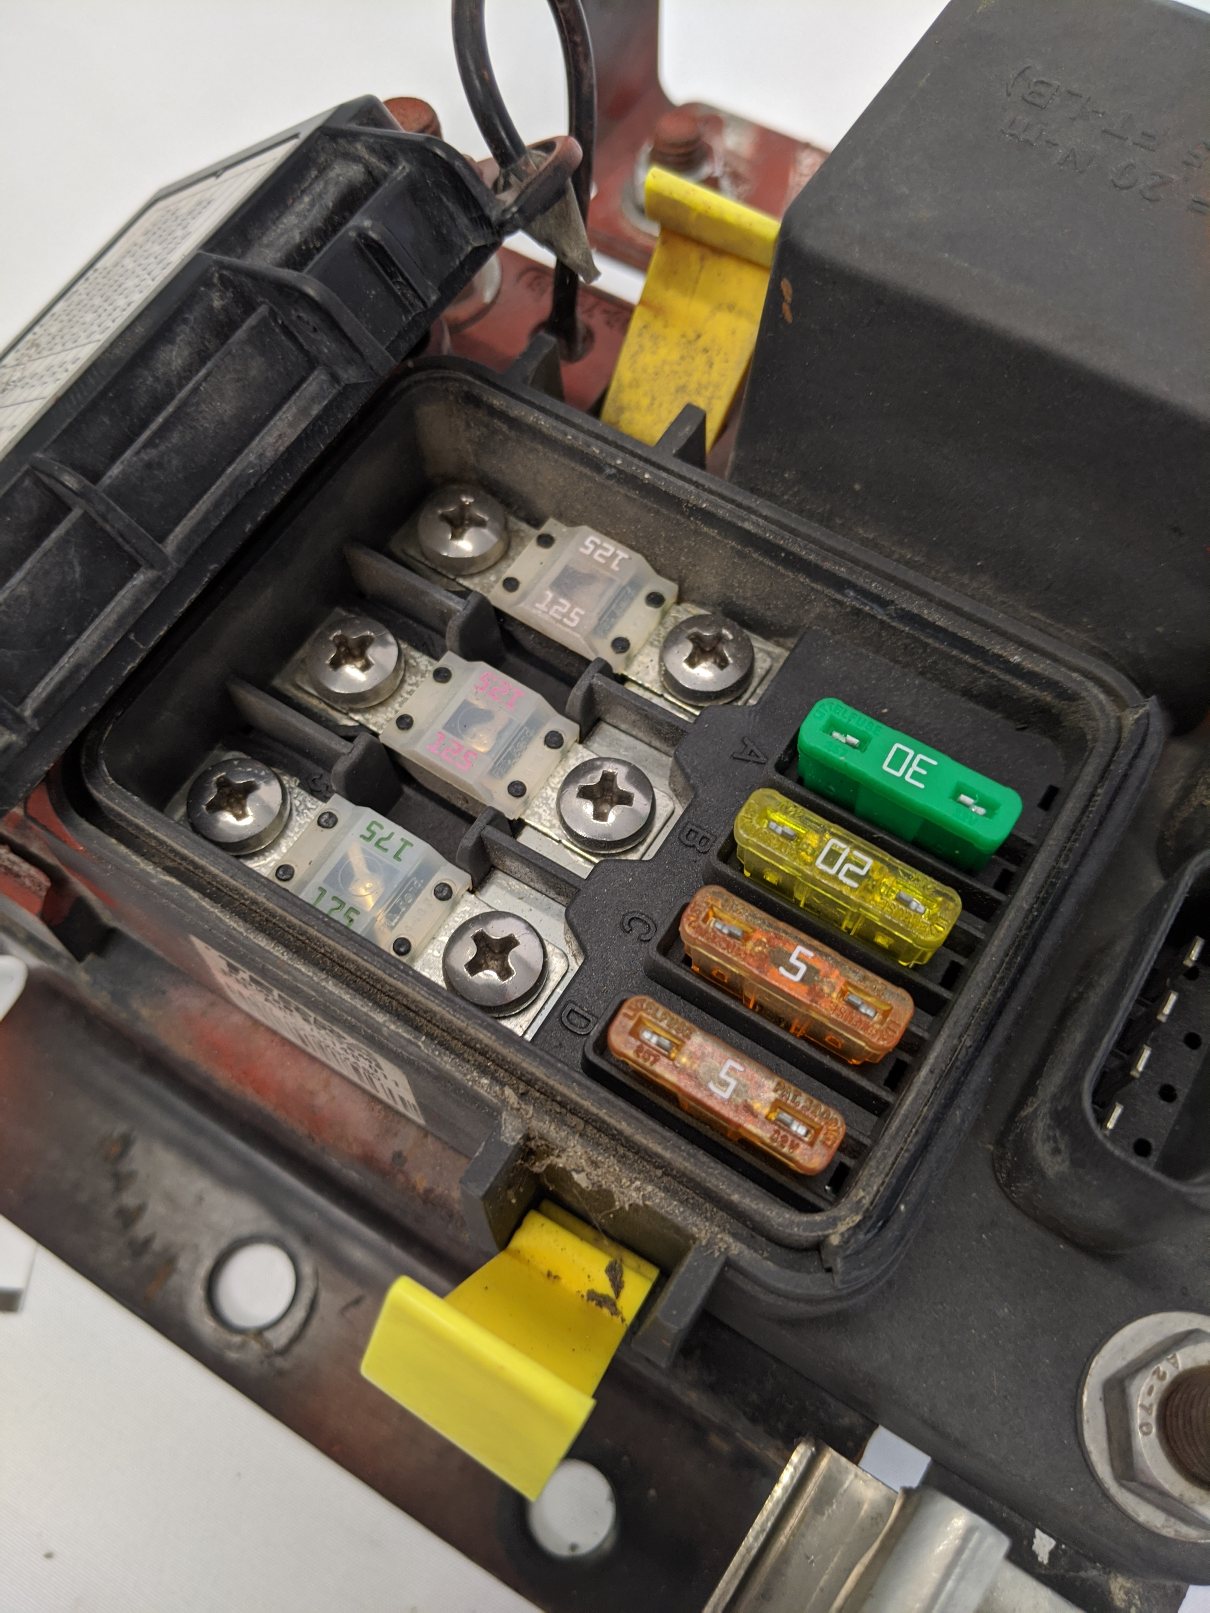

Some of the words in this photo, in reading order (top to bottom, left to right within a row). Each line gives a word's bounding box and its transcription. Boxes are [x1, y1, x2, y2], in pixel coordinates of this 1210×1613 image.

[578, 535, 630, 572] 125
[535, 590, 586, 628] 125
[474, 670, 526, 713] 125
[426, 731, 479, 773] 125
[731, 736, 769, 765] A
[882, 742, 938, 789] 30
[359, 820, 414, 862] 175
[678, 821, 717, 855] B
[815, 838, 874, 888] 20
[619, 911, 657, 942] C
[778, 945, 814, 982] 5
[561, 1001, 600, 1036] D
[707, 1058, 745, 1099] 5
[1138, 1352, 1181, 1437] A2-70
